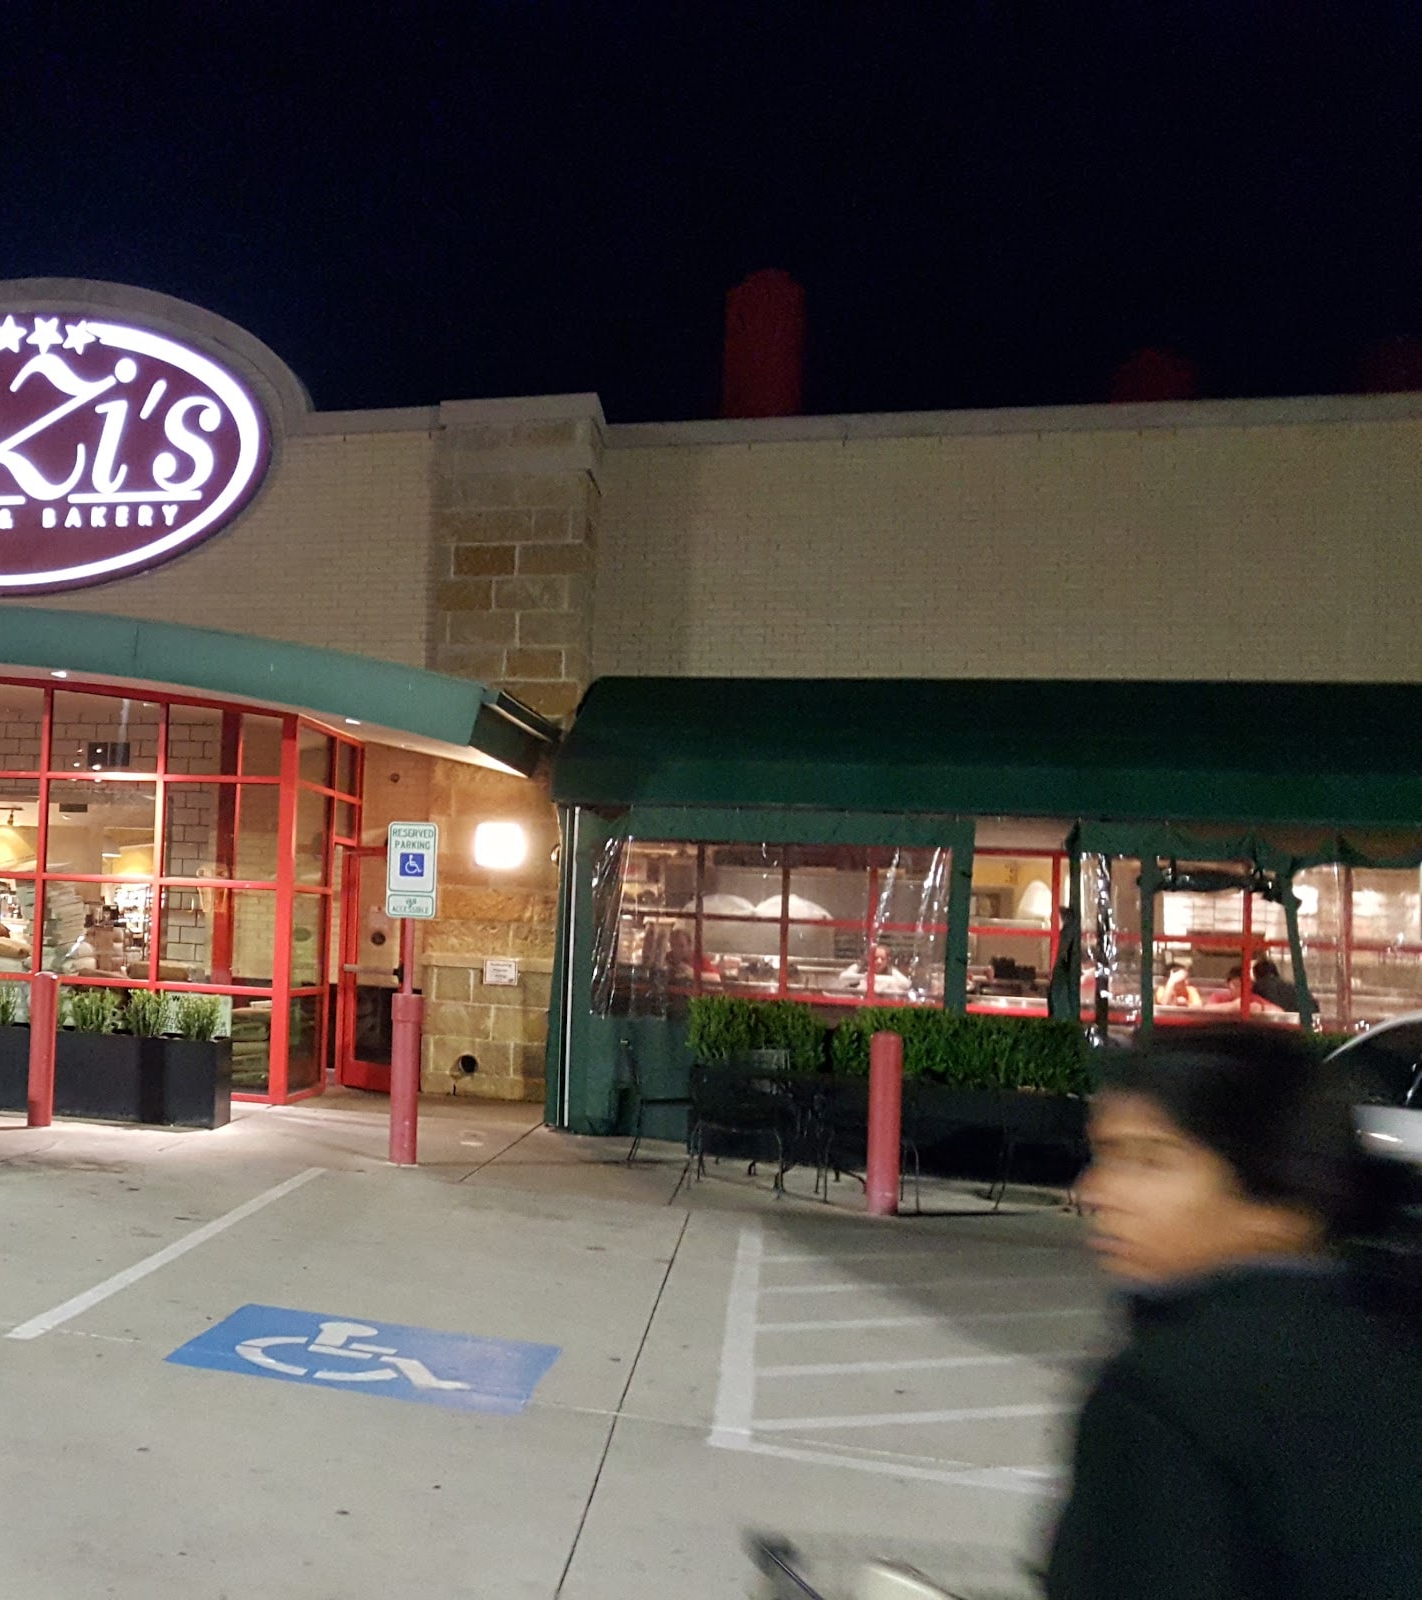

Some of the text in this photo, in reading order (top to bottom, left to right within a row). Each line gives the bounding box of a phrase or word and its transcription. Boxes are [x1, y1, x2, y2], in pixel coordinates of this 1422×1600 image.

[42, 504, 179, 529] BAKERY
[392, 828, 434, 838] RESERVED
[394, 840, 431, 850] PARKING
